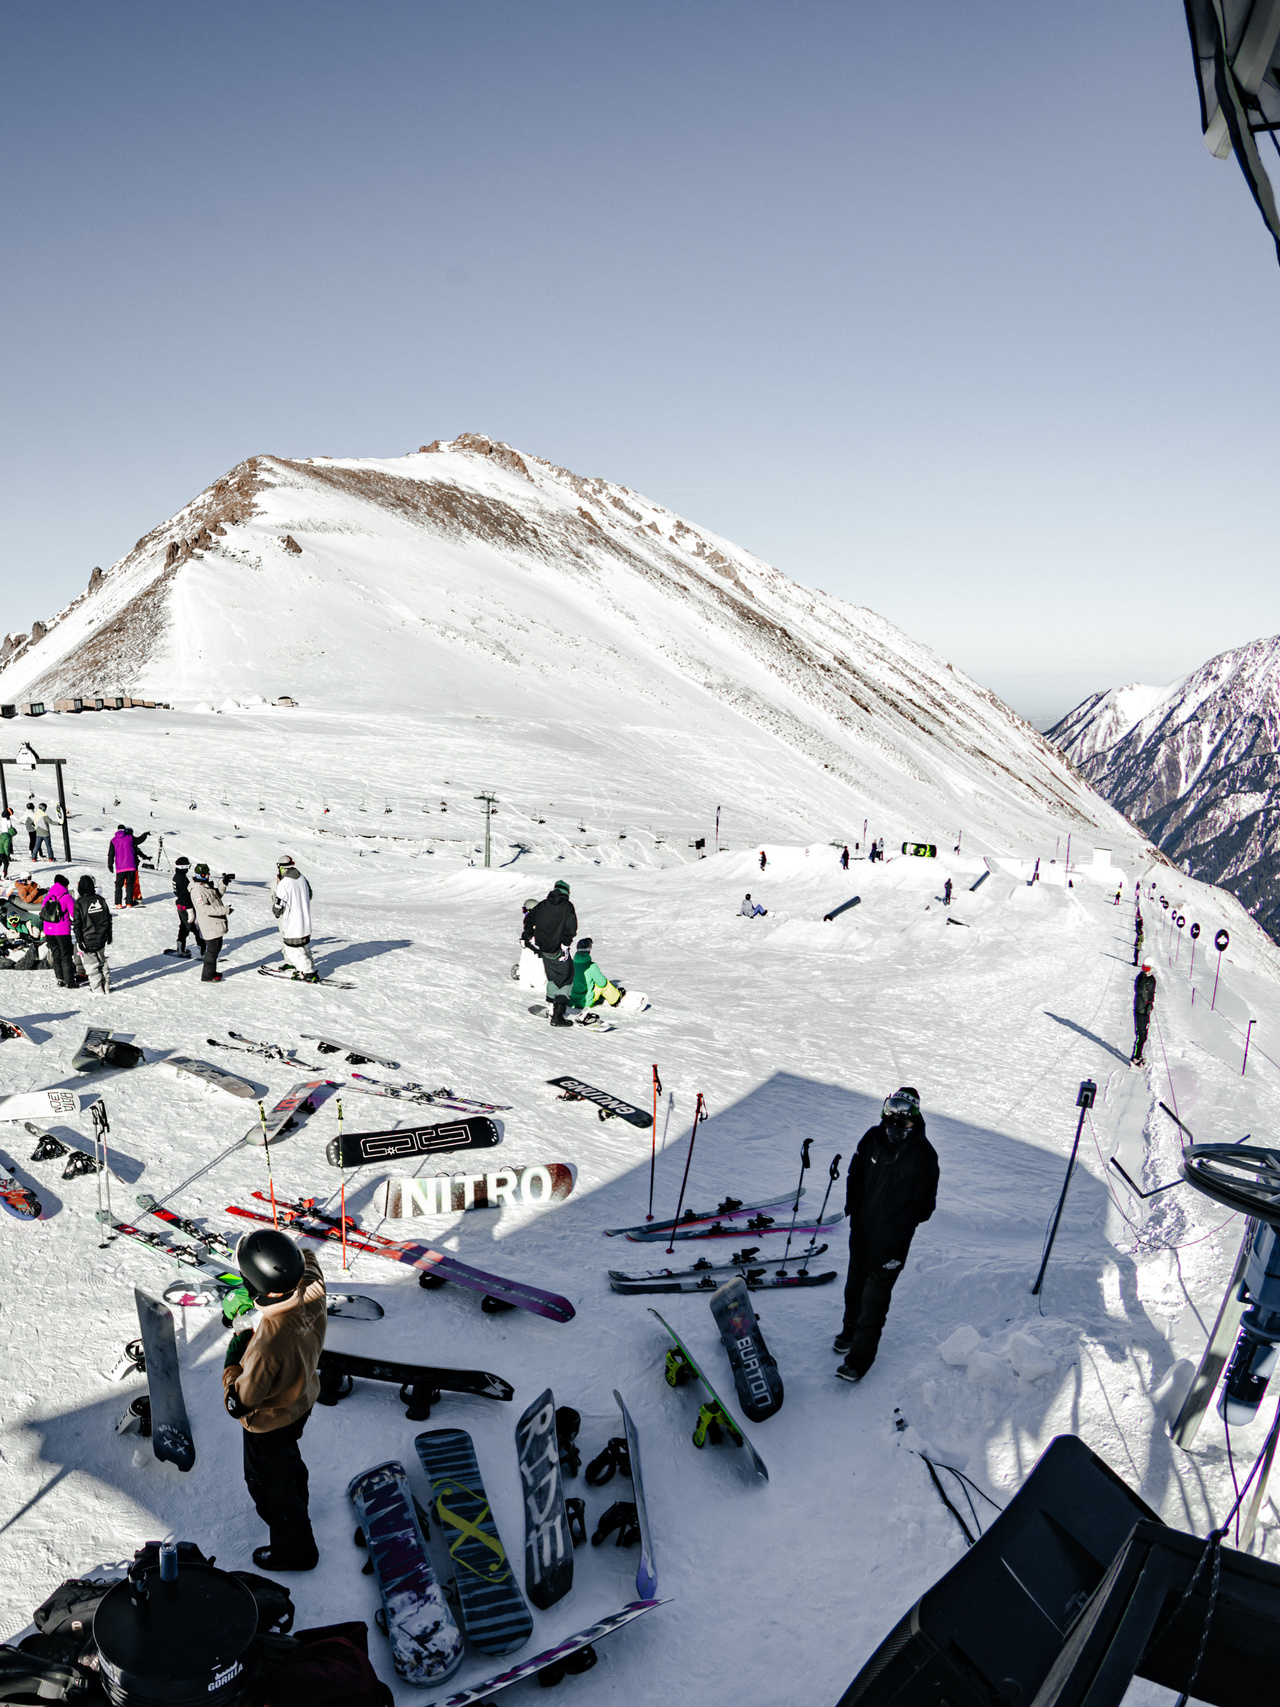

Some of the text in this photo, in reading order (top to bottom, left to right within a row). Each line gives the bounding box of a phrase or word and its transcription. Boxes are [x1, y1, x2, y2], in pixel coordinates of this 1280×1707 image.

[400, 1165, 553, 1218] NITRO
[736, 1336, 773, 1408] BURTON
[158, 1424, 190, 1446] BURTON
[518, 1402, 566, 1585] RIDE
[207, 1662, 244, 1692] GORILLA
